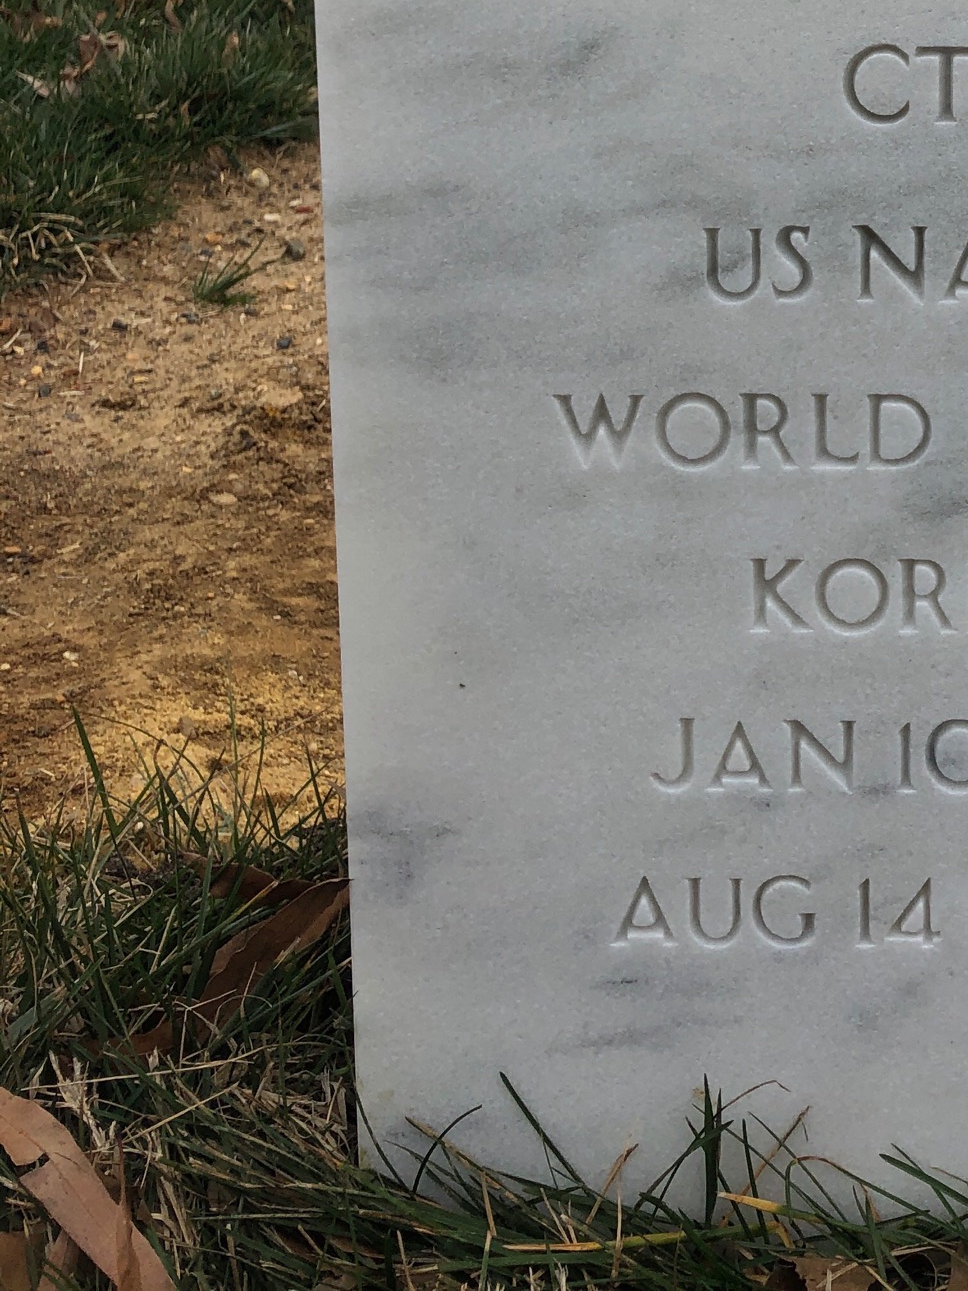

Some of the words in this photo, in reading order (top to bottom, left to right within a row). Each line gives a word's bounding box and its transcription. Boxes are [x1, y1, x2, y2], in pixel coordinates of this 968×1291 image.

[703, 225, 813, 303] US
[552, 391, 933, 471] WORLD
[650, 717, 855, 794] JAN
[609, 875, 819, 948] AUG
[854, 877, 943, 948] 14
